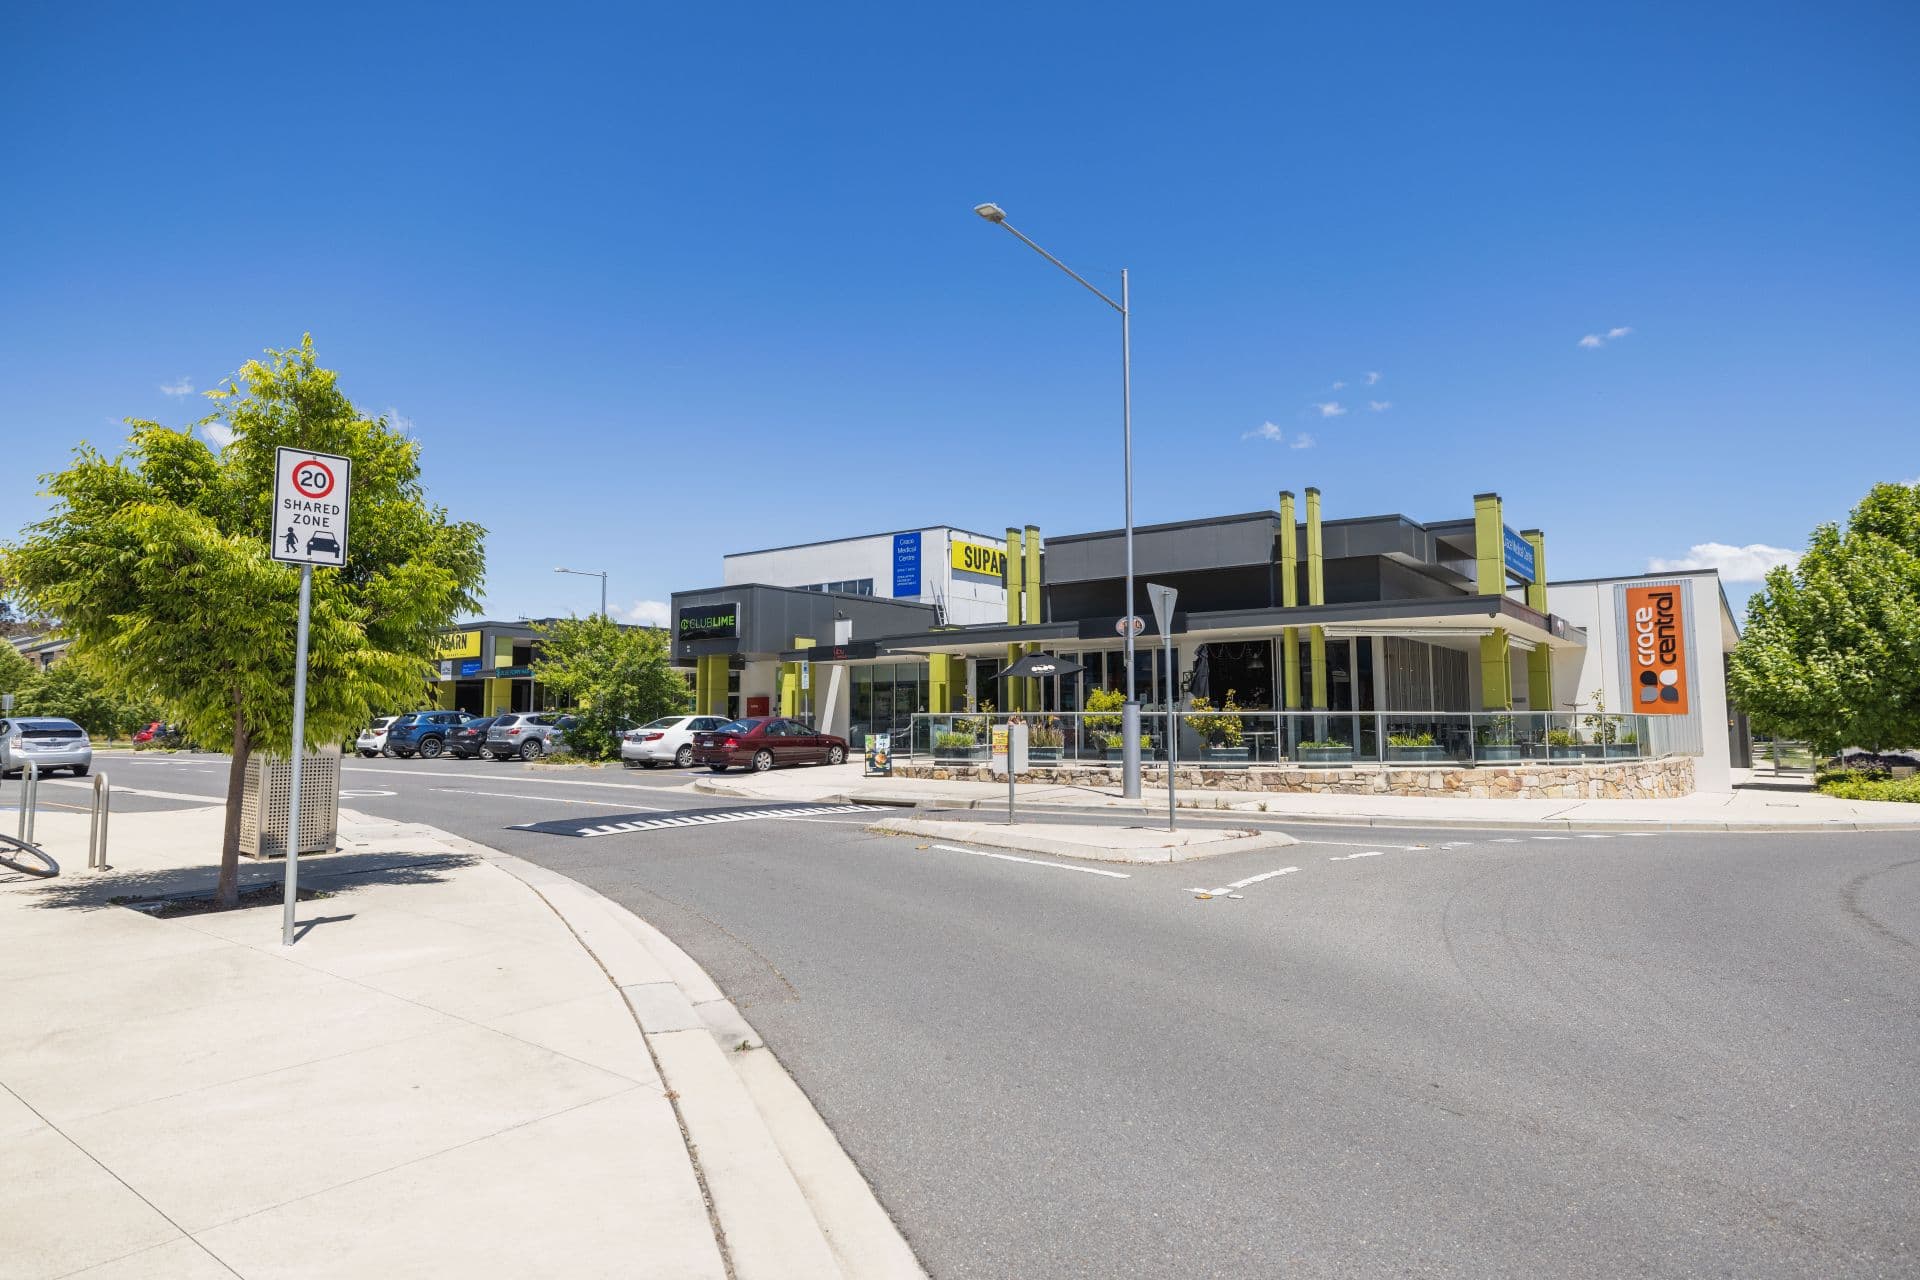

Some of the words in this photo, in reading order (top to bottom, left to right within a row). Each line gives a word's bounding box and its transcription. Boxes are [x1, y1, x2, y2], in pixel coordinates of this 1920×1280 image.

[300, 470, 327, 489] 20
[284, 499, 340, 515] SHARED
[293, 513, 330, 527] ZONE
[1635, 607, 1656, 666] crace
[1647, 592, 1676, 664] central
